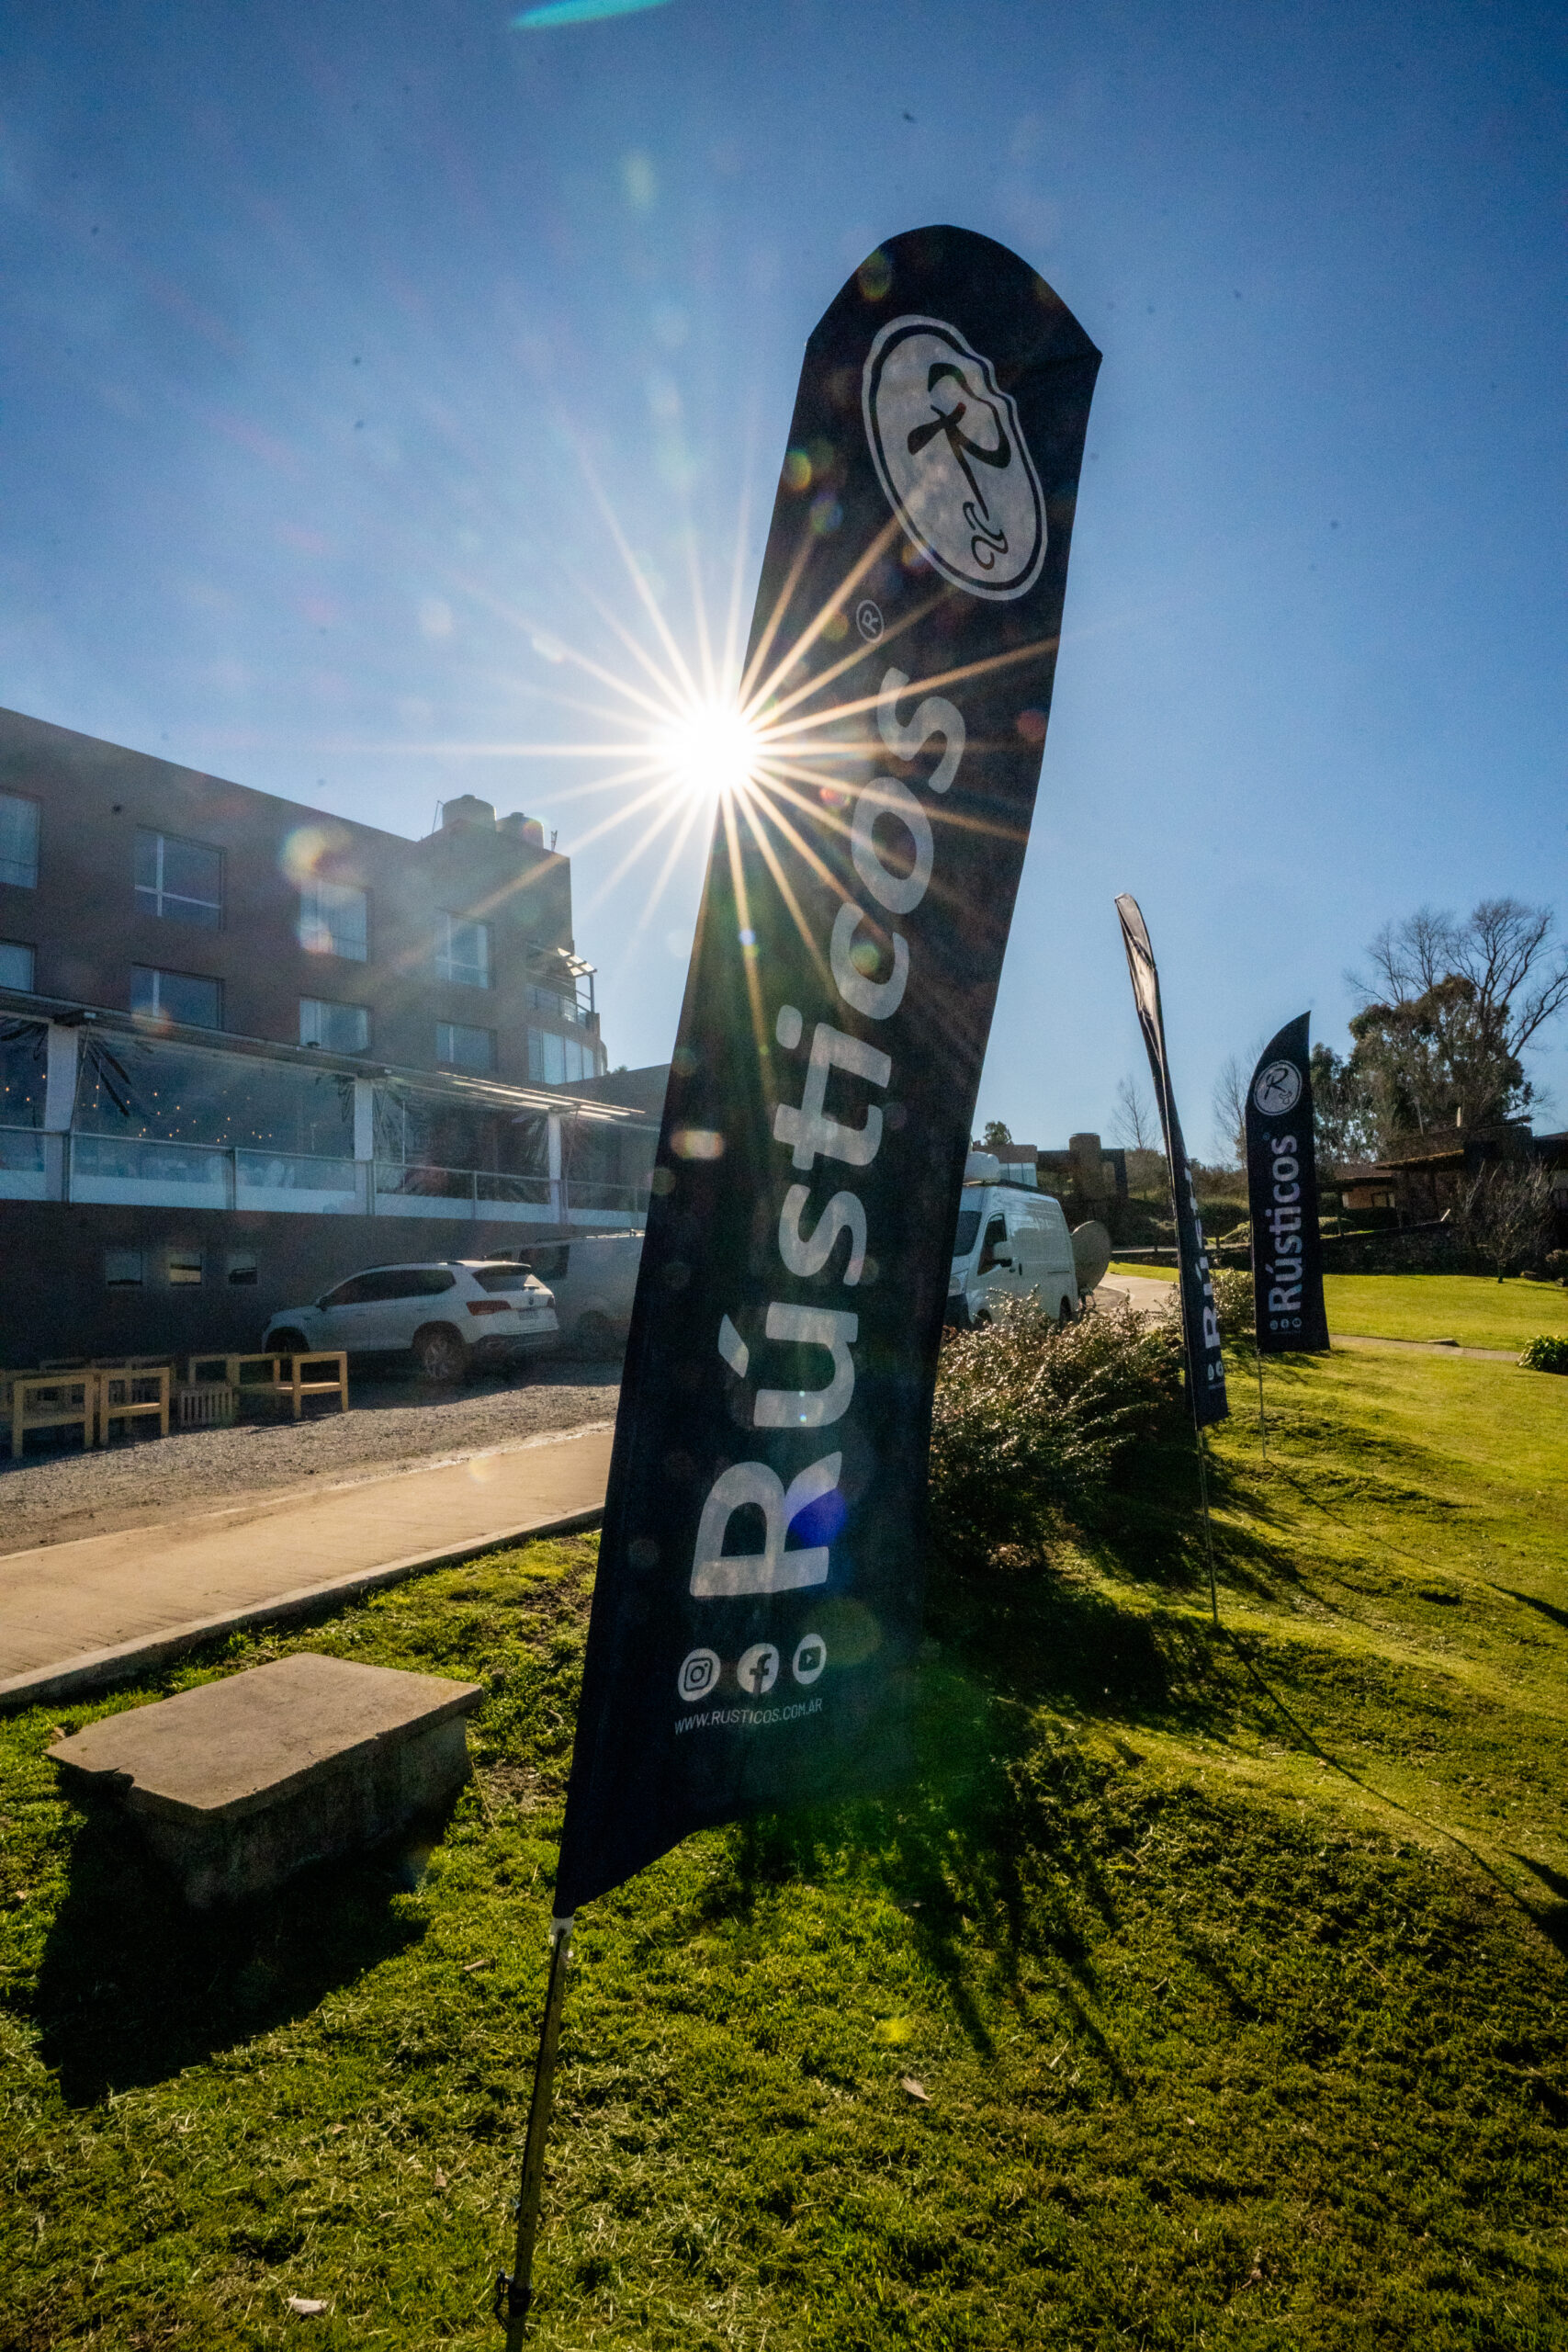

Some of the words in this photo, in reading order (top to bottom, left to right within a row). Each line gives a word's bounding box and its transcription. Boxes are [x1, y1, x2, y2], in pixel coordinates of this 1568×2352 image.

[690, 667, 965, 1597] Rústicos
[1265, 1134, 1303, 1313] Rústicos
[674, 1698, 823, 1736] WWW.RUSTICOS.COM.AR
